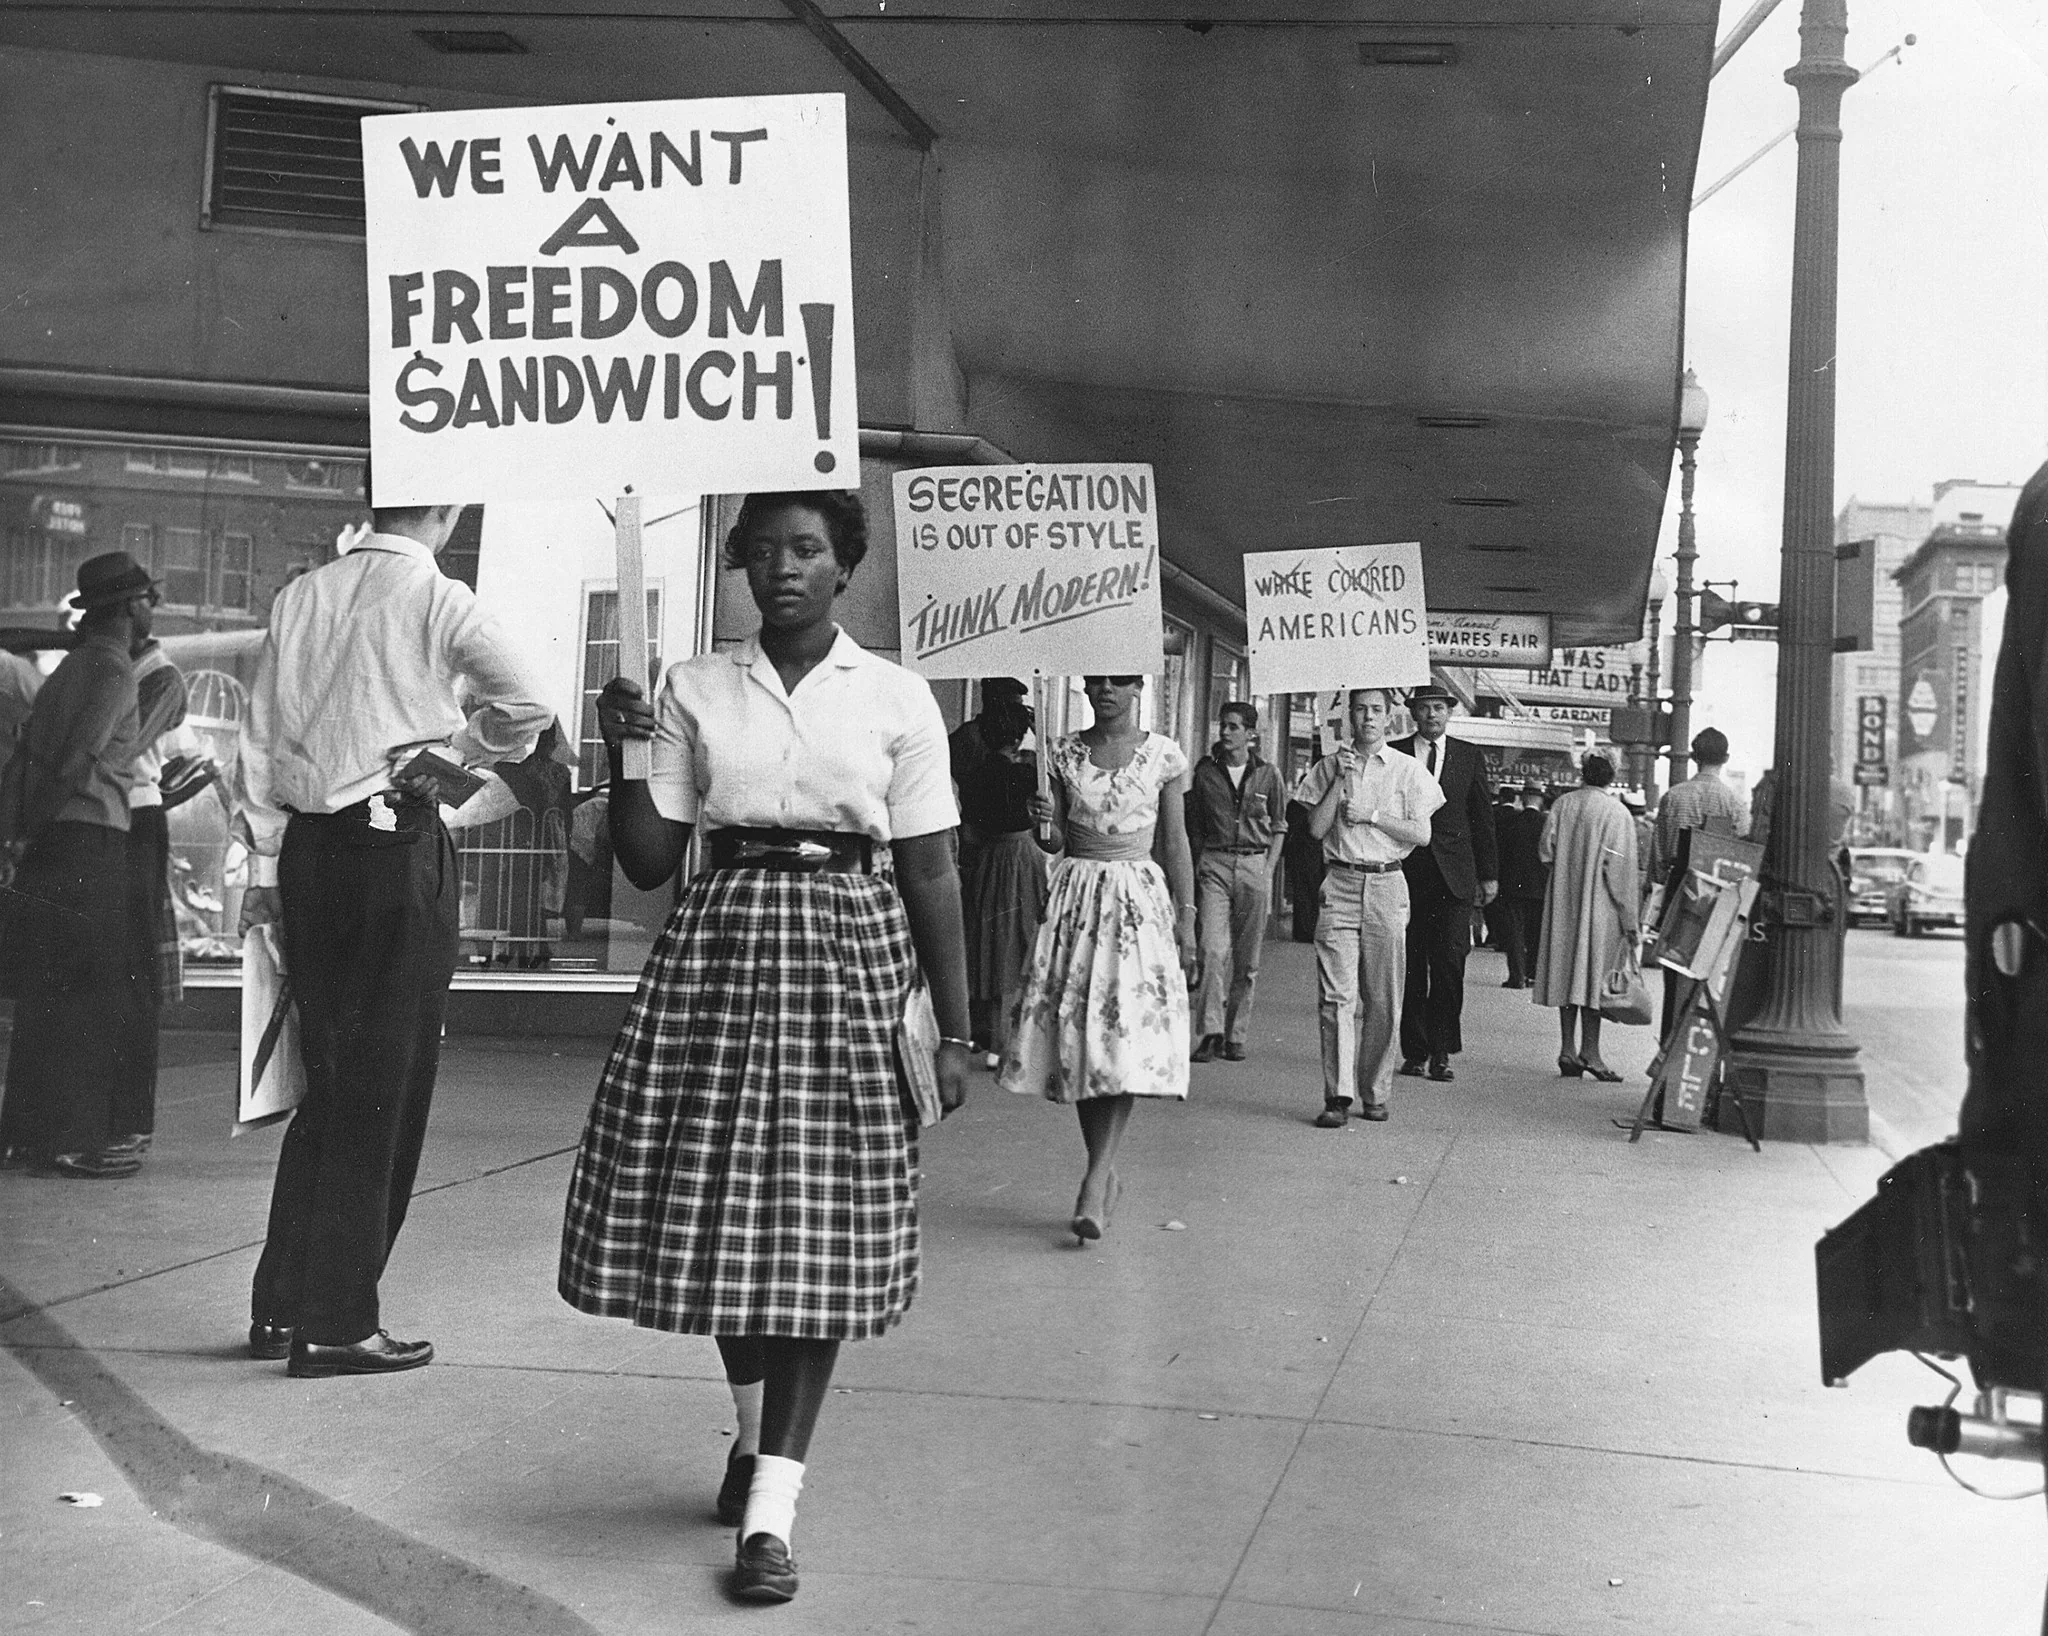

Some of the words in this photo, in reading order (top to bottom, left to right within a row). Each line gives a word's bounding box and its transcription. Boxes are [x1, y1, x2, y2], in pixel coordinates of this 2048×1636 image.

[399, 136, 504, 198] WE
[527, 129, 768, 193] WANT
[539, 197, 640, 256] A
[389, 259, 785, 349] FREEDOM
[908, 474, 1148, 514] SEGREGATION
[912, 523, 939, 551] IS
[946, 523, 998, 550] OUT
[1004, 522, 1039, 549] OF
[1047, 520, 1144, 550] STYLE
[1328, 565, 1405, 592] COLORED
[908, 584, 1007, 651] THINK
[1010, 545, 1156, 625] MODERN!
[1259, 608, 1417, 641] AMERICANS
[1501, 633, 1538, 648] FAIR
[1450, 648, 1499, 658] FLOOR
[1562, 648, 1605, 669] WAS
[1528, 669, 1573, 687] THAT
[1582, 671, 1632, 693] LADY
